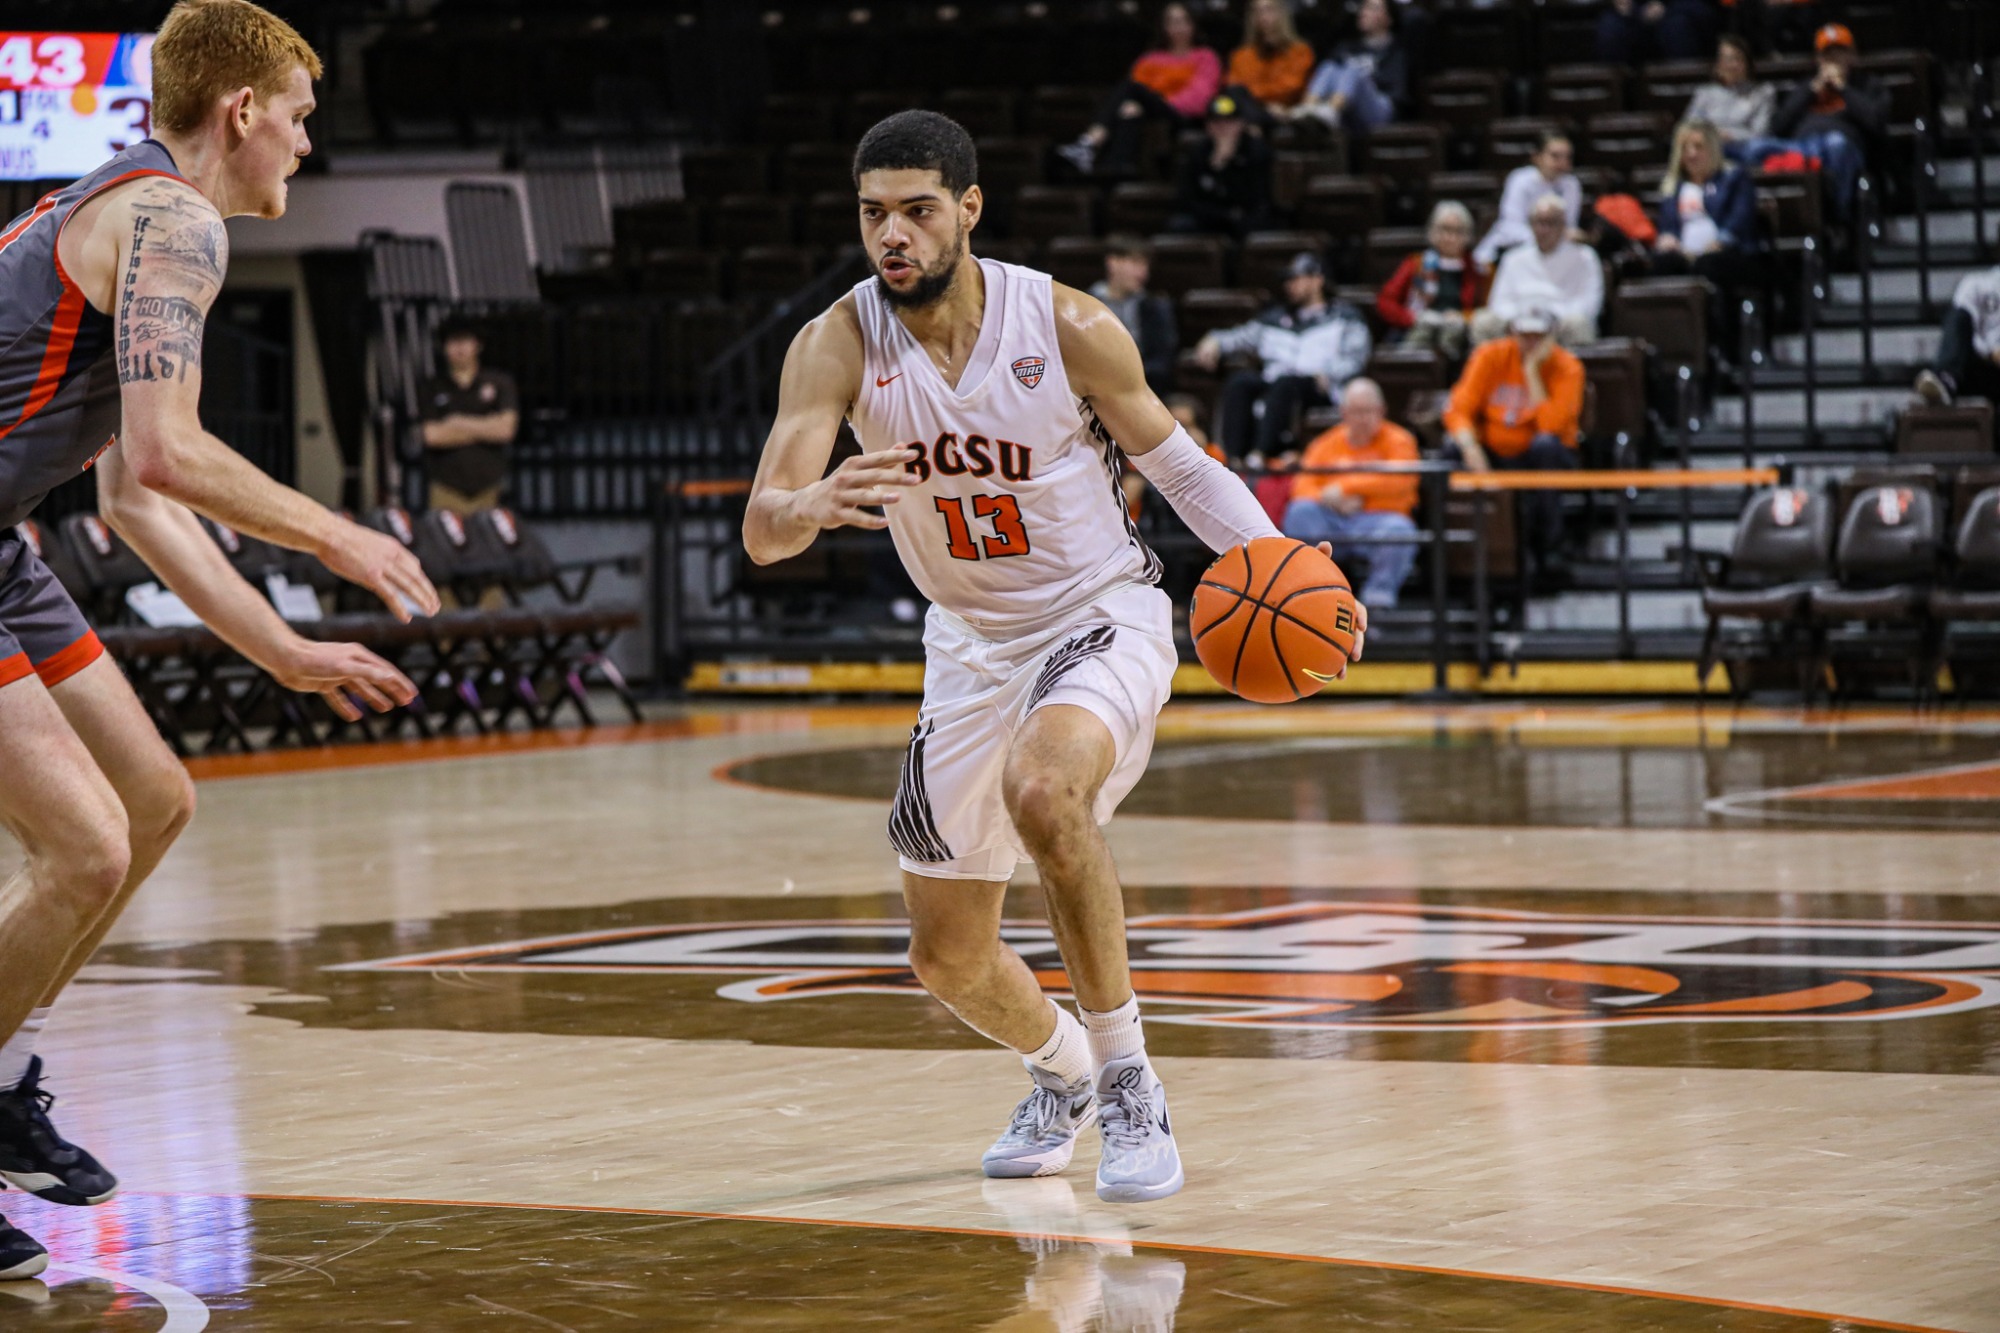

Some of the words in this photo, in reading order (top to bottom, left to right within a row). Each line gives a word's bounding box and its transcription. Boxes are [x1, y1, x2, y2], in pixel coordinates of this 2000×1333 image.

[0, 35, 87, 88] 43
[134, 215, 151, 233] if
[1014, 364, 1044, 378] MAC
[905, 431, 1035, 484] BGSU
[933, 494, 1031, 561] 13
